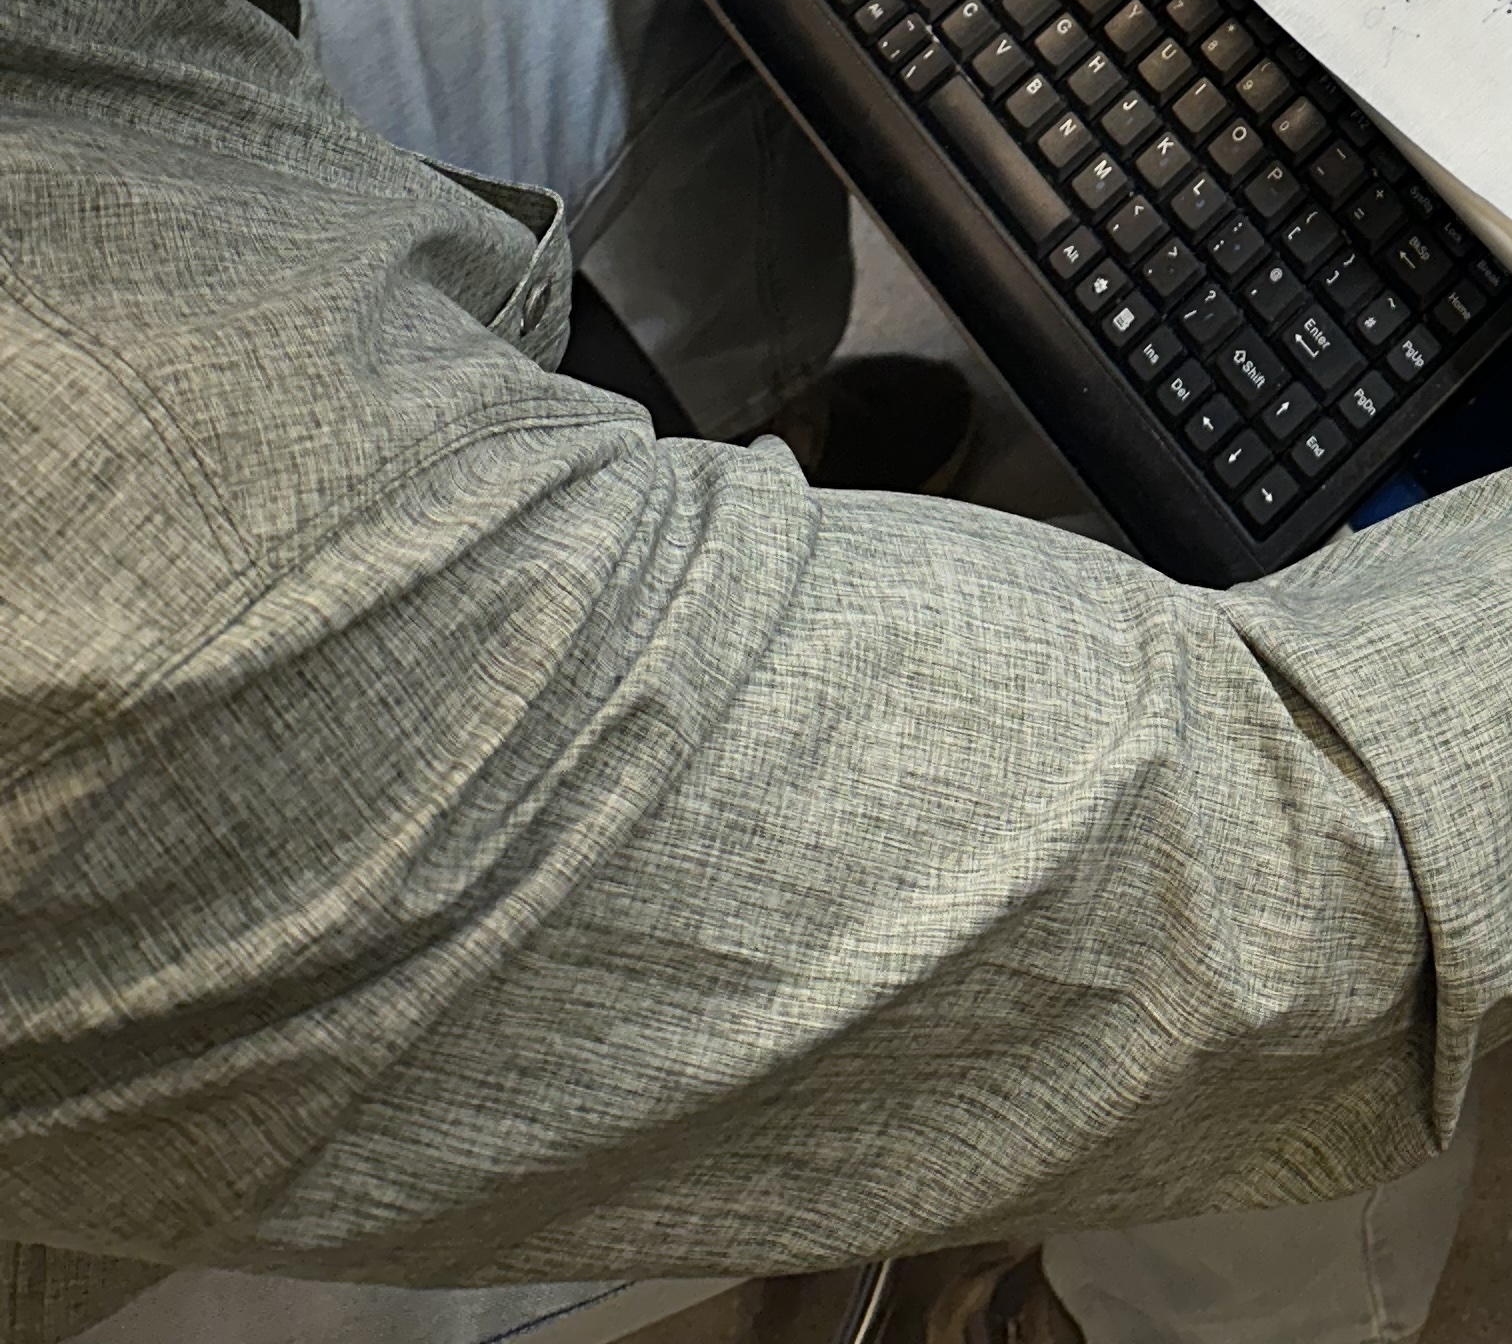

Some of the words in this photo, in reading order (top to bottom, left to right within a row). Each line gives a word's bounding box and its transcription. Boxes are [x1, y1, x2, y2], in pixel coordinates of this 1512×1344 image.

[962, 2, 978, 17] C
[1128, 4, 1143, 19] Y
[1056, 18, 1072, 34] G
[996, 39, 1012, 55] V
[1161, 43, 1177, 60] U
[1088, 55, 1105, 73] H
[1026, 77, 1043, 95] B
[1122, 99, 1138, 111] J
[1059, 118, 1077, 137] N
[1231, 125, 1247, 141] O
[1157, 136, 1174, 155] K
[1093, 159, 1113, 179] M
[1267, 166, 1283, 180] P
[1193, 179, 1206, 196] L
[1063, 245, 1079, 263] Alt
[1408, 236, 1430, 261] BkSp
[1448, 291, 1471, 320] Home
[1303, 317, 1331, 350] Enter
[1143, 343, 1159, 365] Ins
[1402, 339, 1425, 367] PgUp
[1242, 360, 1266, 389] Shift
[1170, 377, 1191, 401] Del
[1354, 387, 1376, 415] PgDn
[1306, 435, 1325, 458] End
